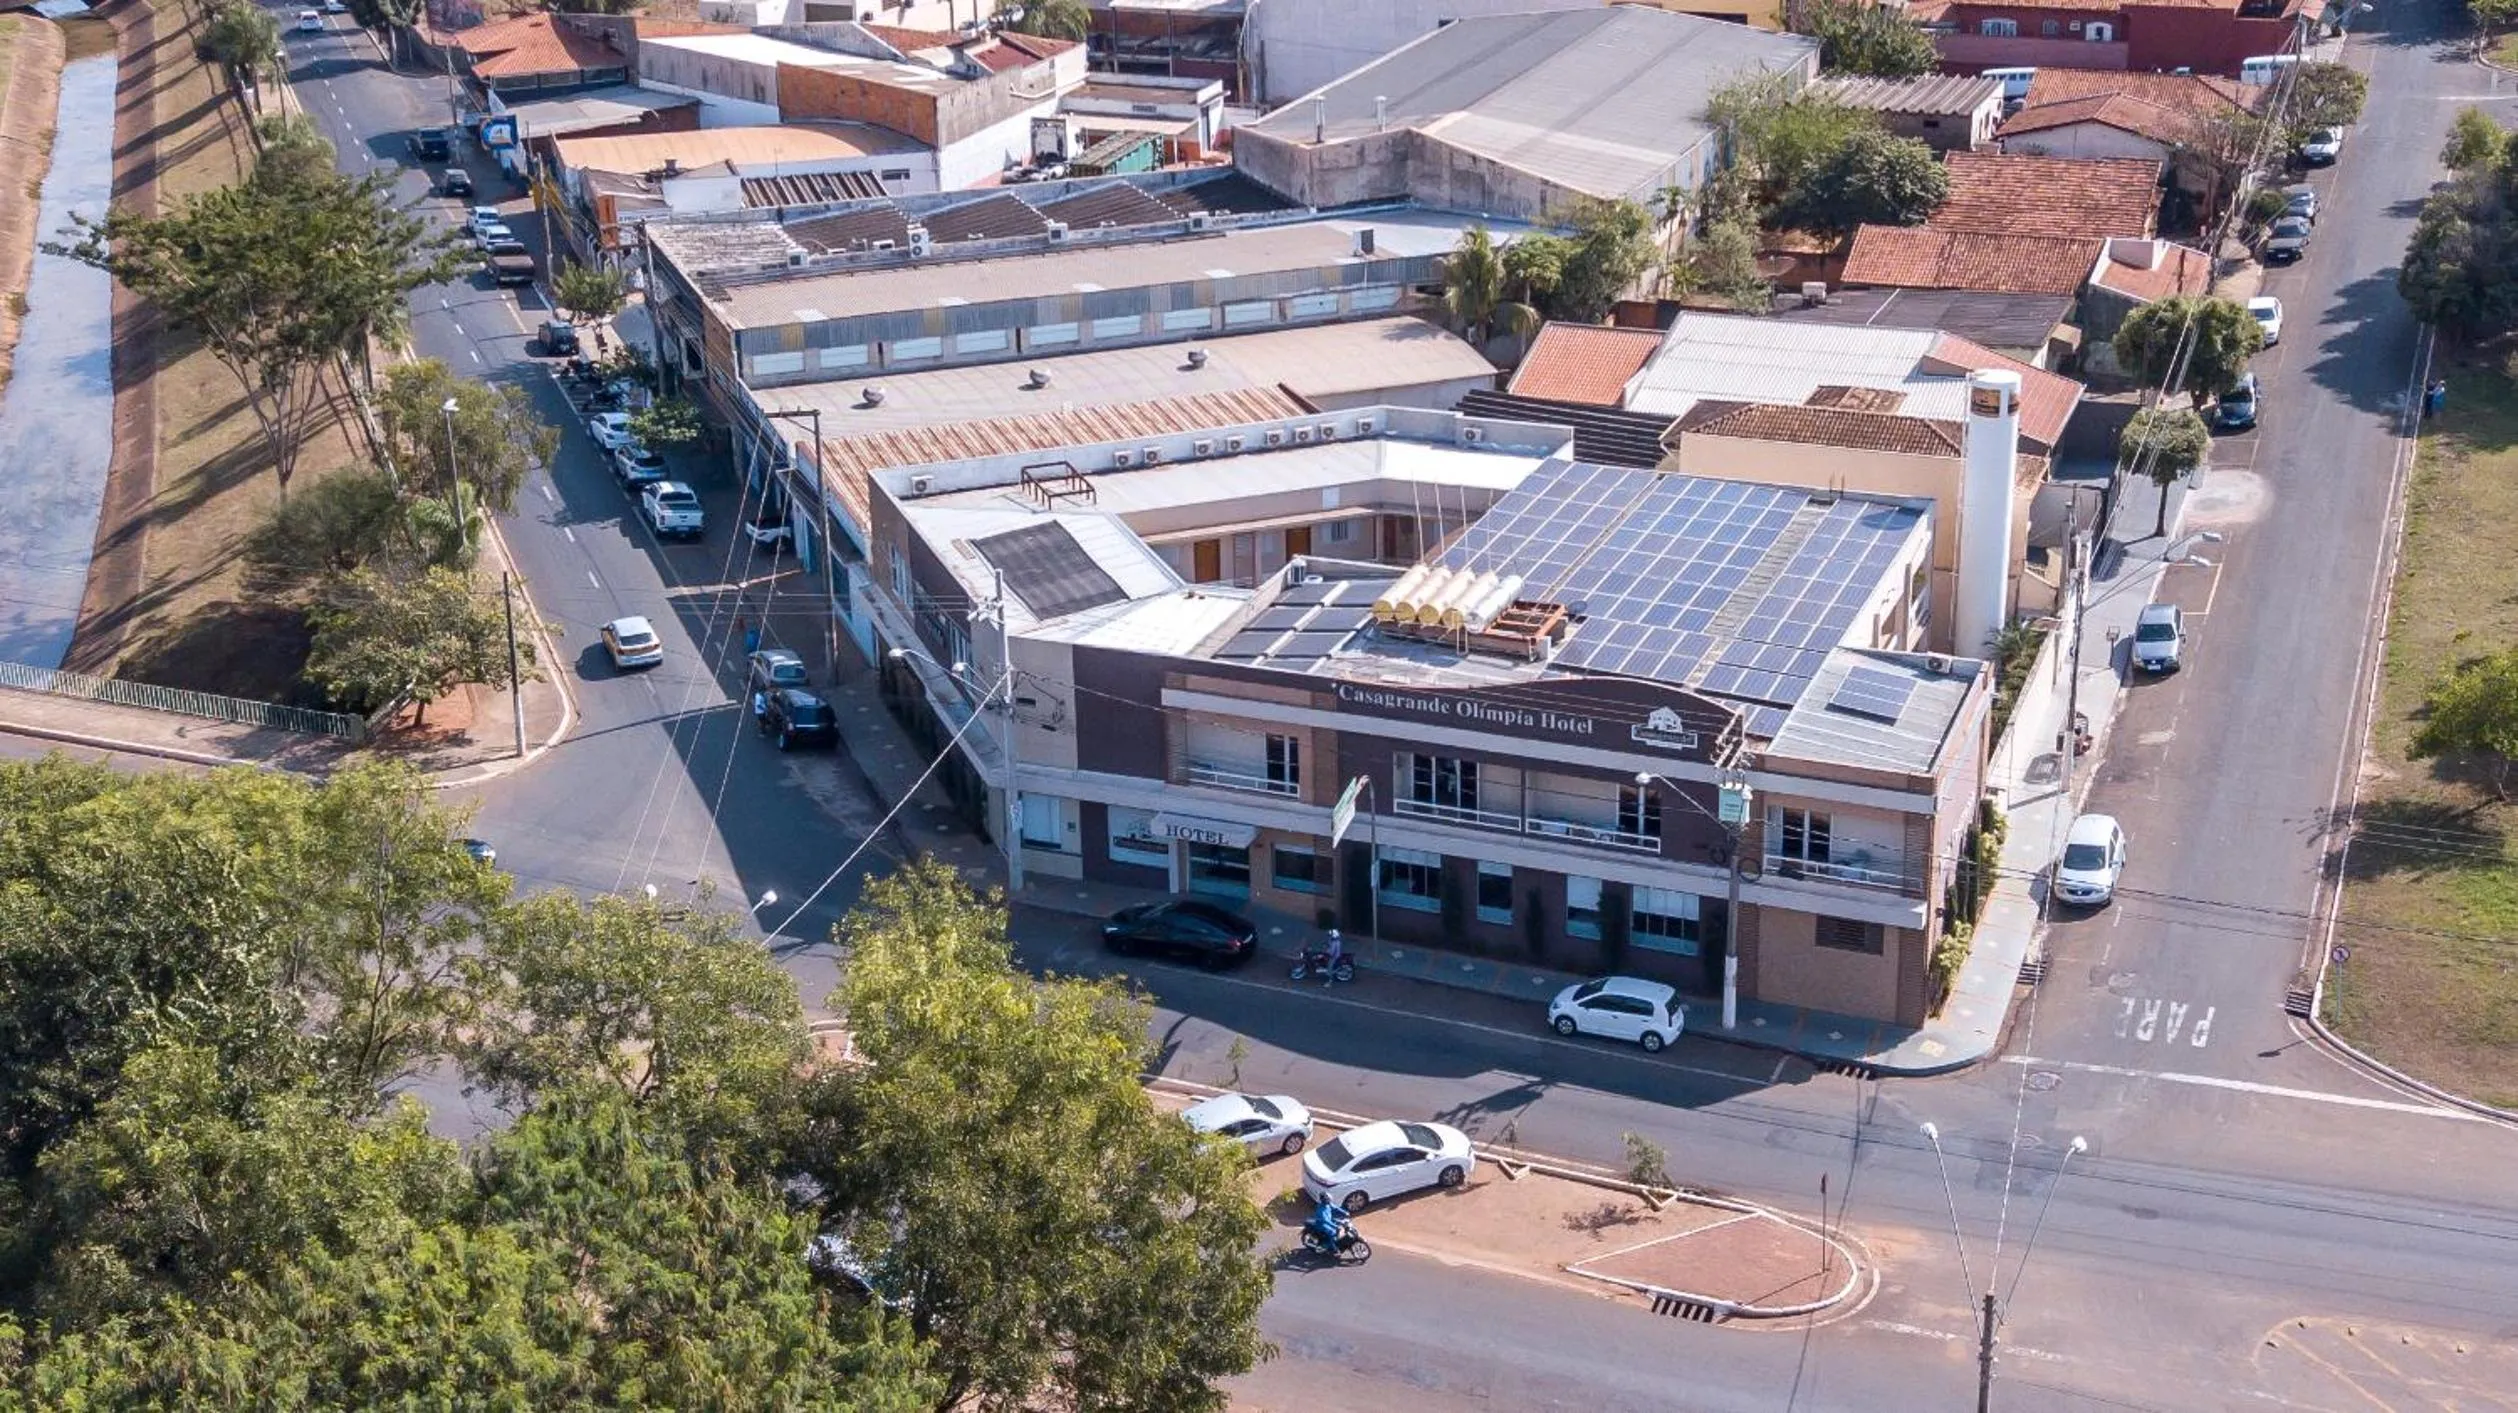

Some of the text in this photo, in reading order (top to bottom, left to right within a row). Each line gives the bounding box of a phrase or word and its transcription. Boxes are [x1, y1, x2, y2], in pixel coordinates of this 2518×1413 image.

[1339, 684, 1593, 734] Casagrande Olímpia Hotel
[1166, 824, 1231, 845] HOTEL
[2114, 997, 2216, 1048] PARE
